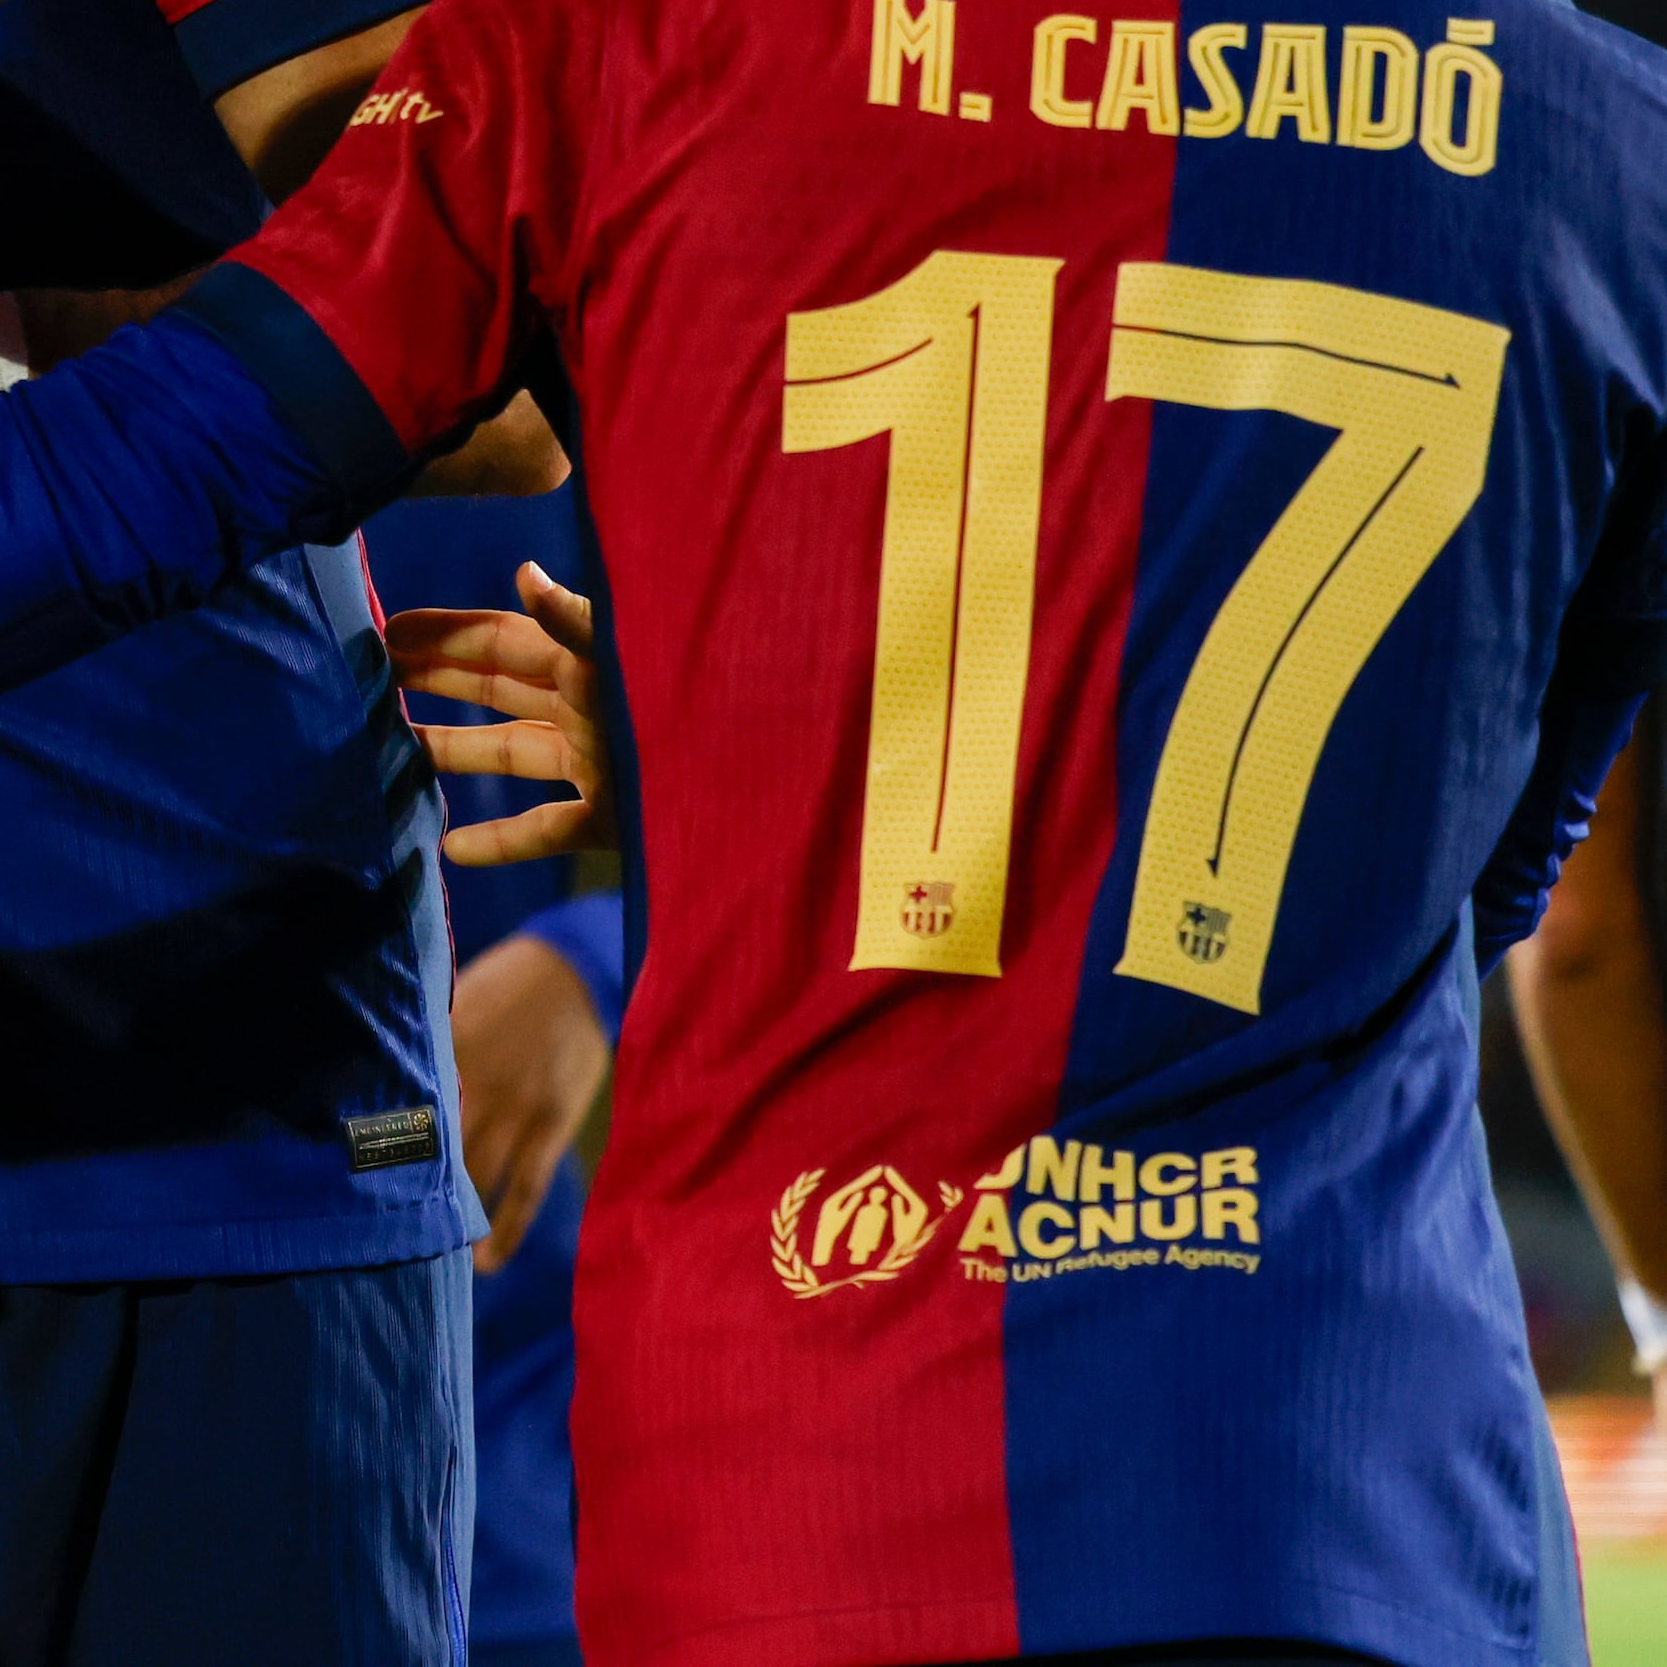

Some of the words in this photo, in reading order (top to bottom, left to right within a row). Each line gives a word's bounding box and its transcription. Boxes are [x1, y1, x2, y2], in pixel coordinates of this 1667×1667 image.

[1028, 14, 1503, 176] CASADÓ
[781, 250, 1510, 1014] 17
[957, 1187, 1260, 1260] ACNUR
[960, 1257, 1008, 1283] The
[1012, 1262, 1052, 1282] UN
[1056, 1248, 1161, 1274] Refugee
[1164, 1244, 1261, 1274] Agency
